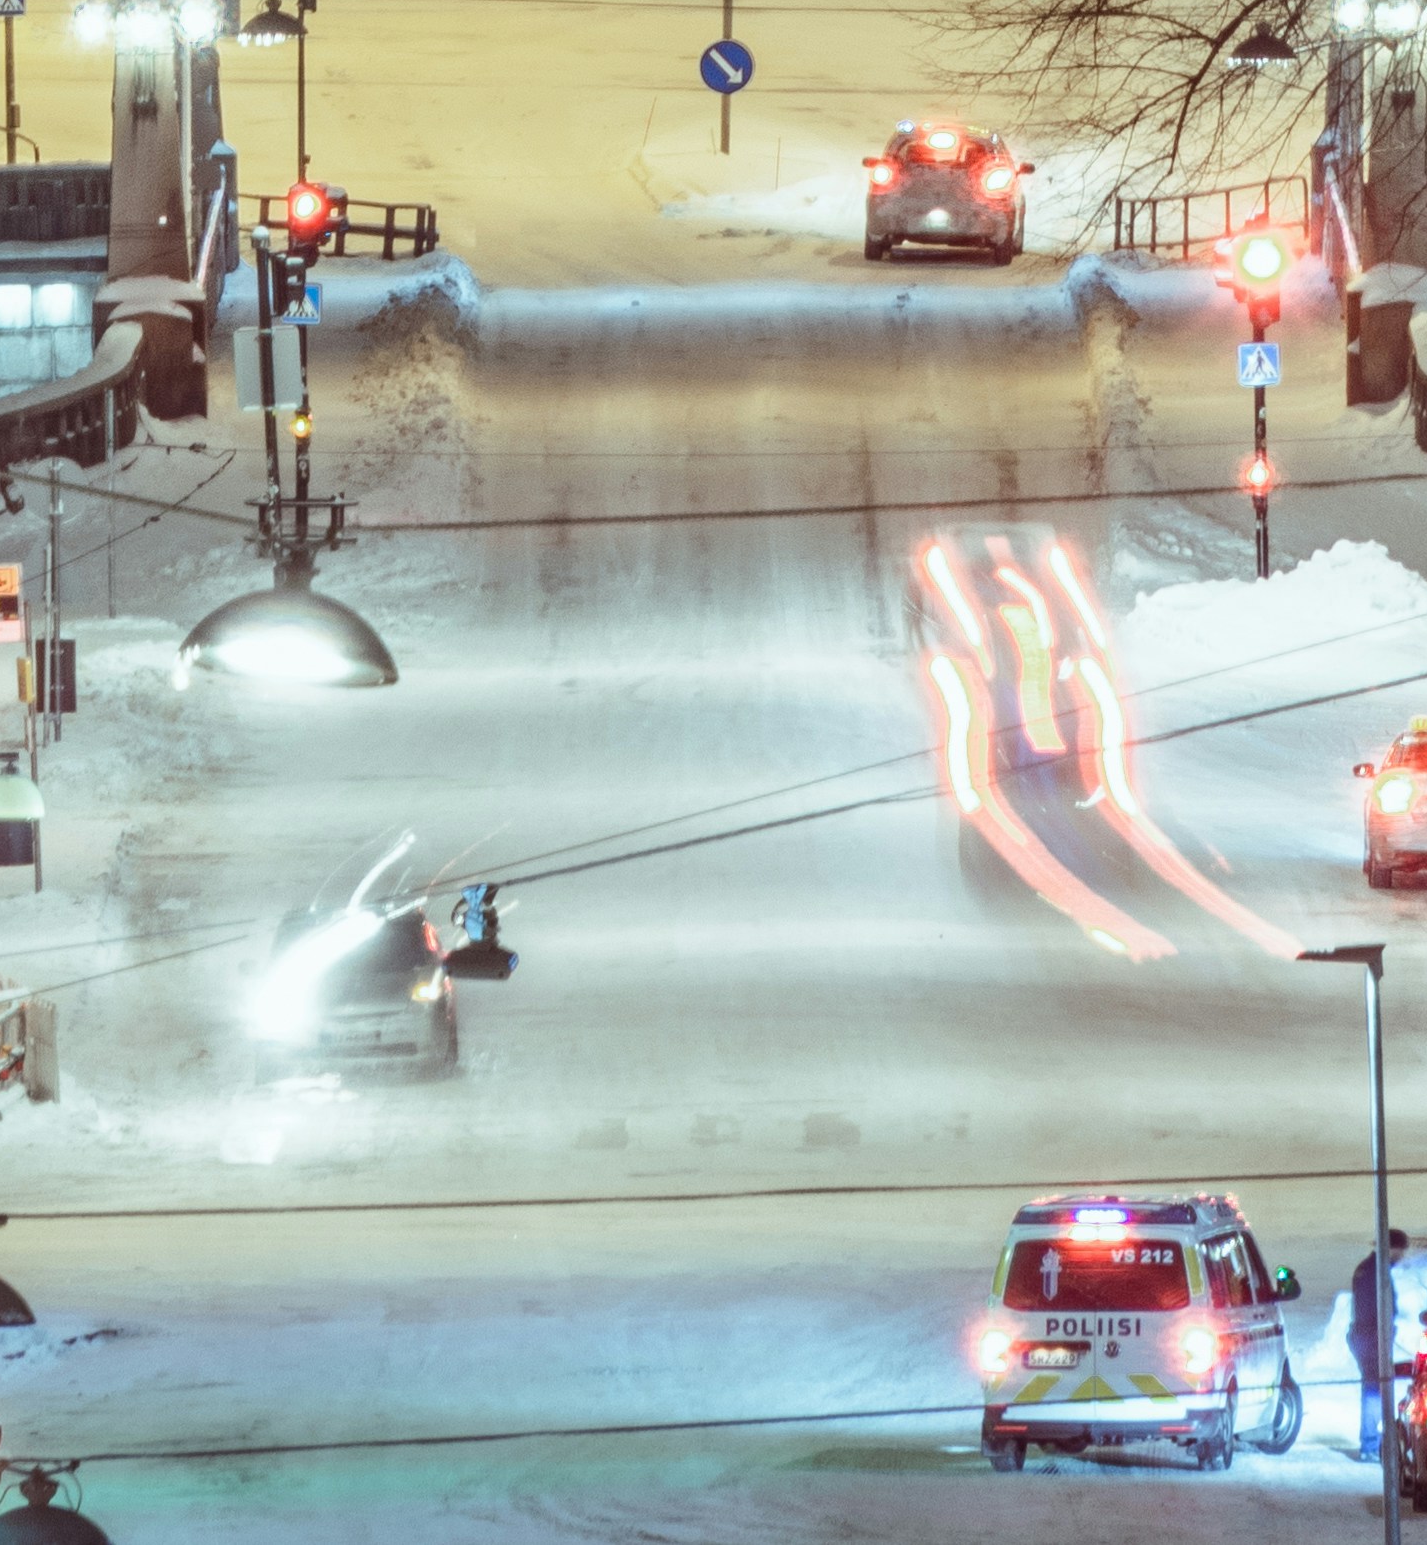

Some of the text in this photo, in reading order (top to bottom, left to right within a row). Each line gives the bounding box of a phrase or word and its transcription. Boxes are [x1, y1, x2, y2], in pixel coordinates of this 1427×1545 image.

[1111, 1249, 1174, 1263] VS 212
[1046, 1318, 1141, 1337] POLIISI
